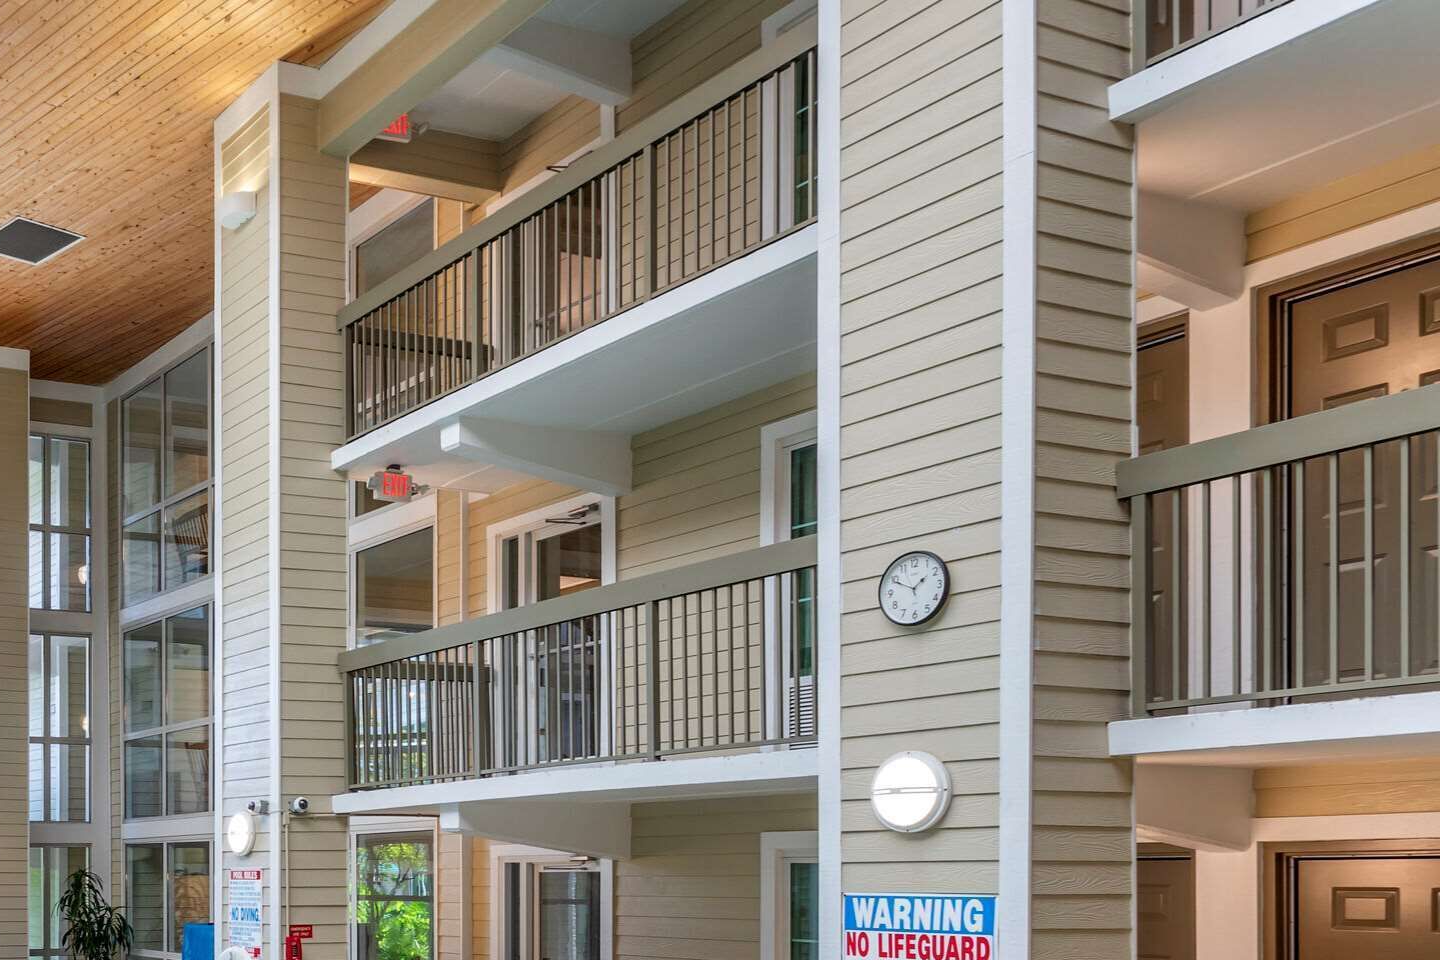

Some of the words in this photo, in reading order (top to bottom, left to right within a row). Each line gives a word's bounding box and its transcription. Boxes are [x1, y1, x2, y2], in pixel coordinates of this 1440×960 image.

[384, 472, 408, 497] EXIT
[910, 558, 919, 568] 12
[932, 567, 939, 576] 2
[937, 580, 942, 589] 3
[888, 589, 893, 598] 9
[932, 593, 938, 601] 4
[892, 601, 898, 609] 8
[924, 604, 930, 613] 5
[901, 609, 907, 618] 7
[912, 610, 918, 619] 6
[232, 907, 239, 921] NO
[852, 897, 984, 933] WARNING
[846, 931, 870, 957] NO
